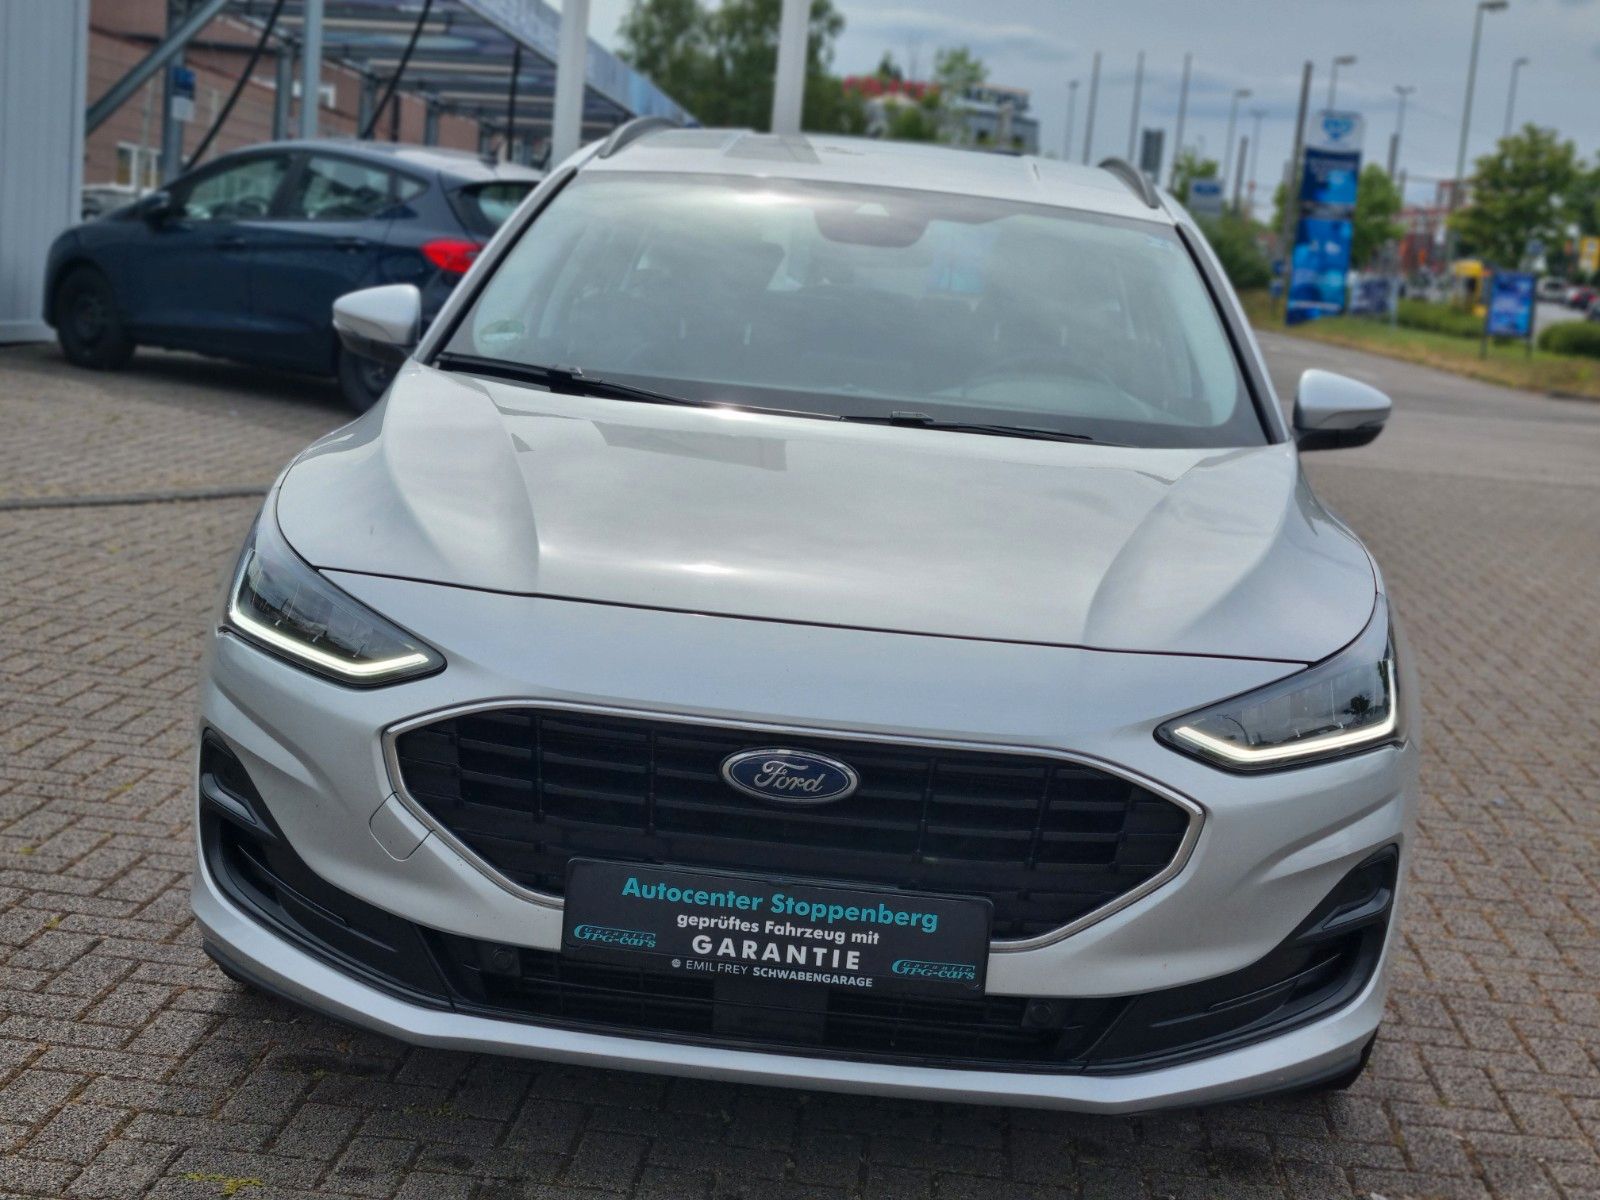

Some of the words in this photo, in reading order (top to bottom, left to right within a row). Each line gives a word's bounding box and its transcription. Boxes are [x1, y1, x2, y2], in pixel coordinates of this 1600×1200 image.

[754, 760, 826, 793] Ford
[621, 877, 763, 912] Autocenter
[770, 893, 939, 932] Stoppenberg
[676, 912, 760, 933] geprüftes
[764, 920, 846, 946] Fahrzeug
[851, 930, 880, 945] mit
[691, 934, 860, 970] GARANTIE
[686, 960, 716, 974] EMIL
[717, 963, 749, 977] FREY
[753, 967, 873, 987] SCHWABENGARAGE
